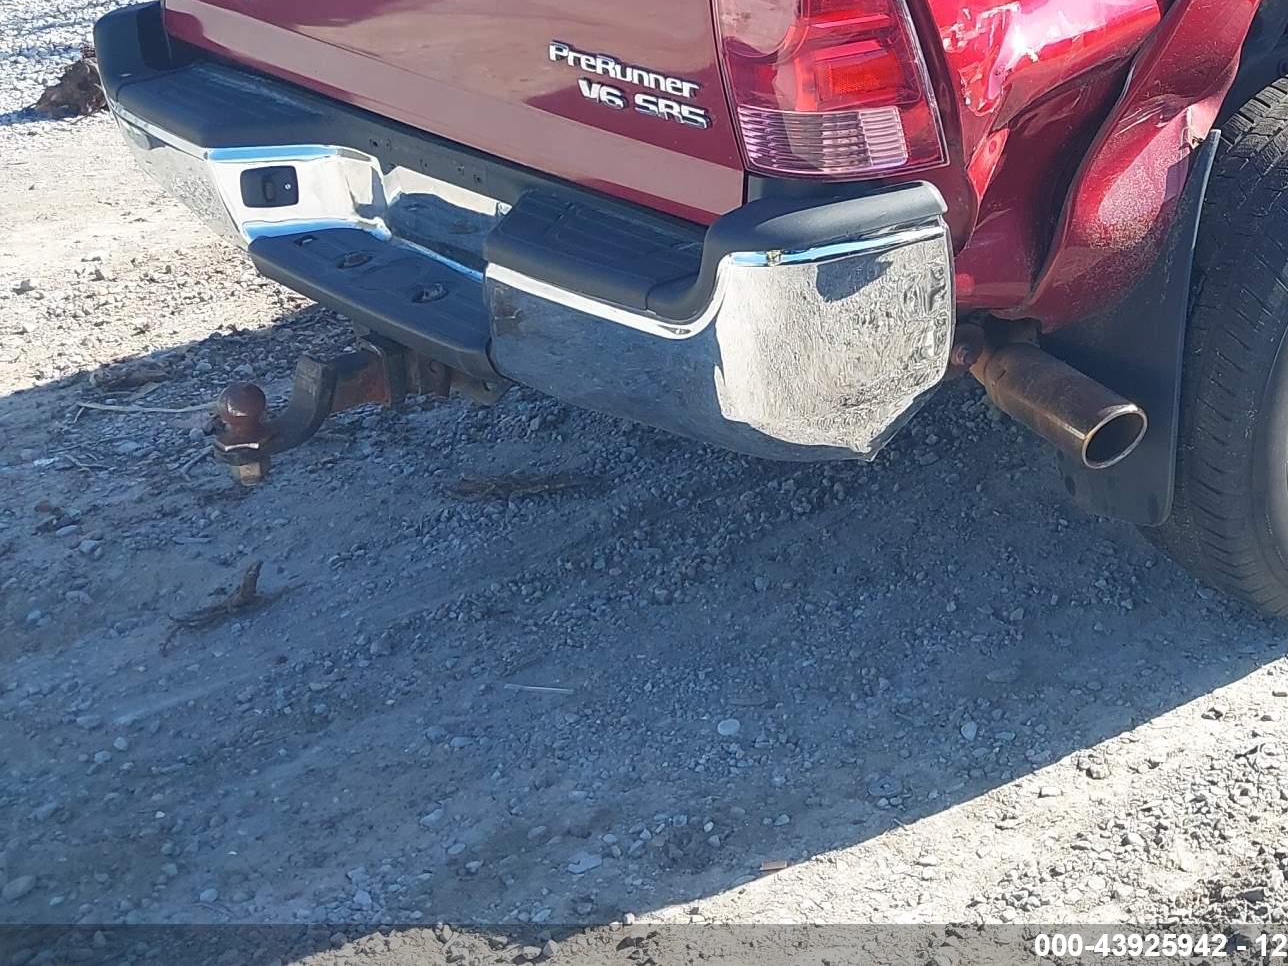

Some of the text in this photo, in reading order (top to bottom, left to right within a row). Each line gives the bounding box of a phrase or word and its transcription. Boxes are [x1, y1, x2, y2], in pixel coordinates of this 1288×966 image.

[549, 40, 700, 98] PreRunner
[577, 78, 711, 130] V6 SR5
